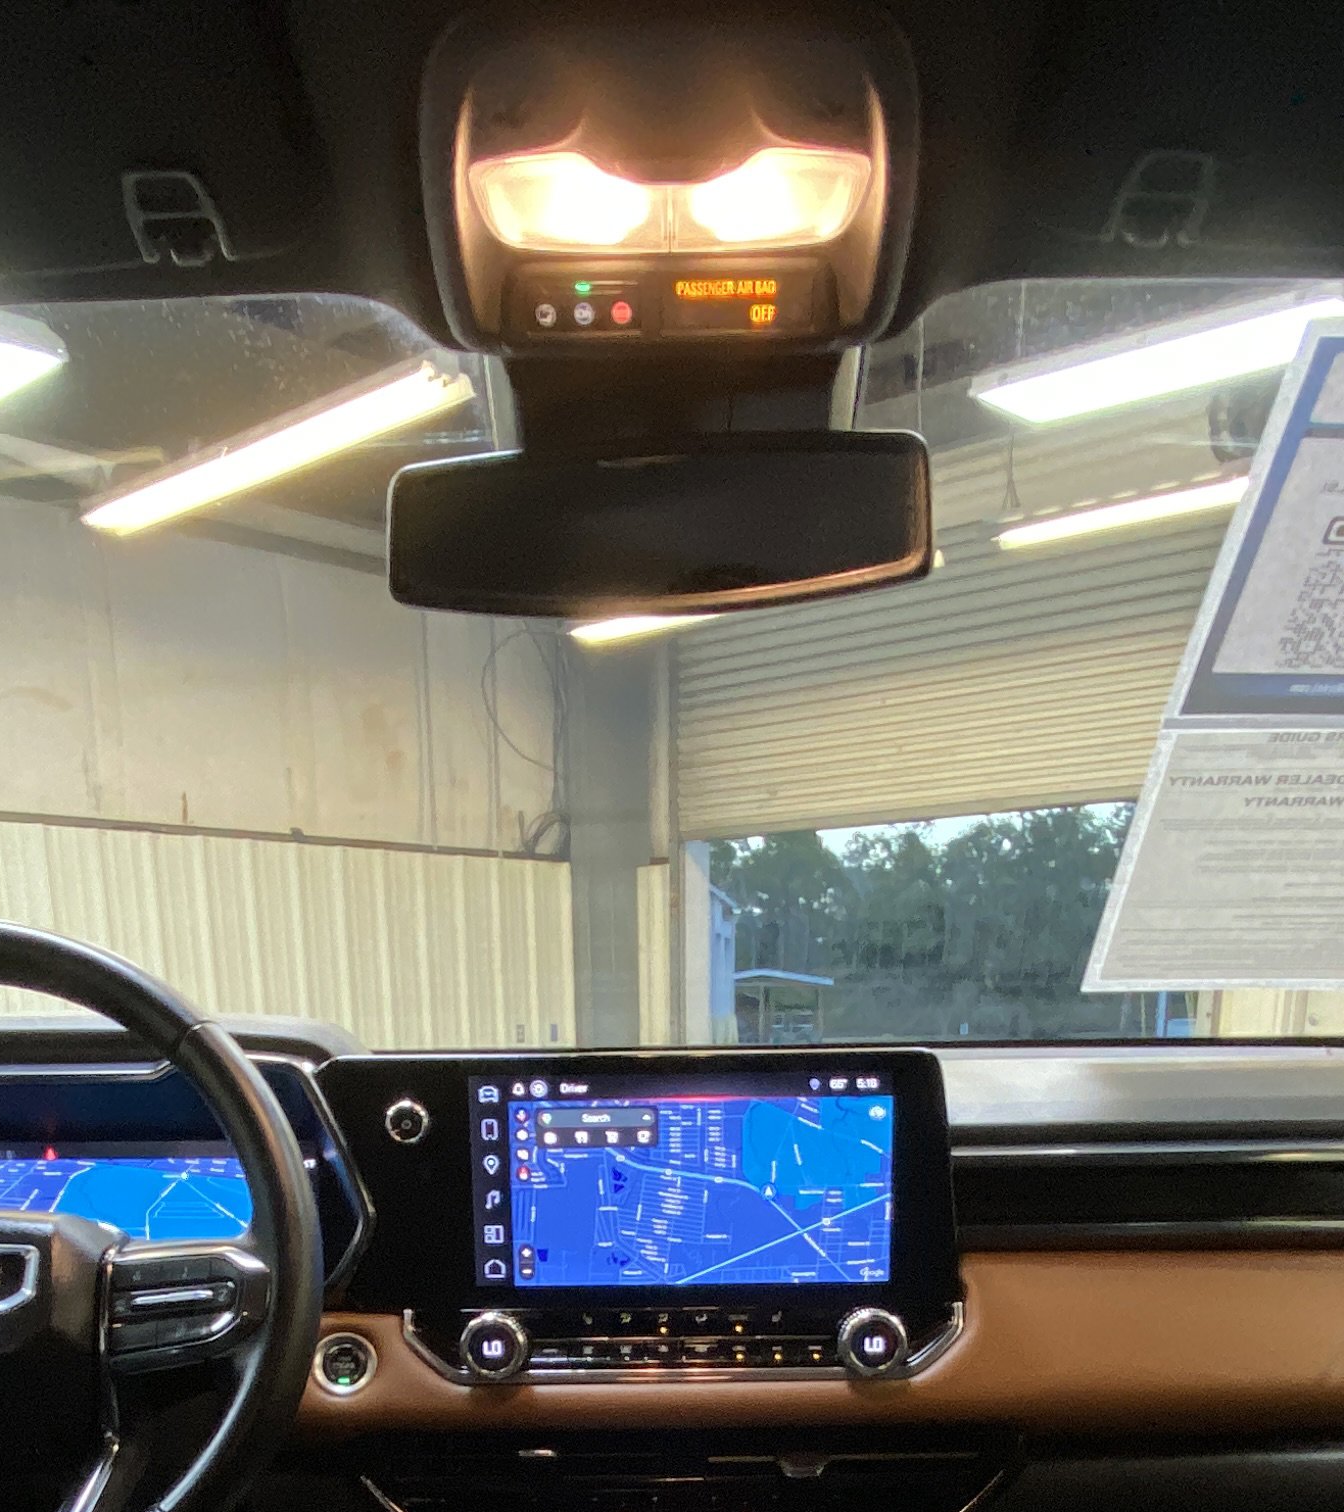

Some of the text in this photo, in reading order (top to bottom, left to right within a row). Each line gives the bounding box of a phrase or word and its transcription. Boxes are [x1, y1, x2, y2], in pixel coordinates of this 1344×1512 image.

[675, 280, 735, 296] PASSENGER
[736, 280, 754, 294] AIR
[750, 303, 776, 323] OFF
[482, 1340, 503, 1356] LO
[863, 1336, 884, 1353] LO
